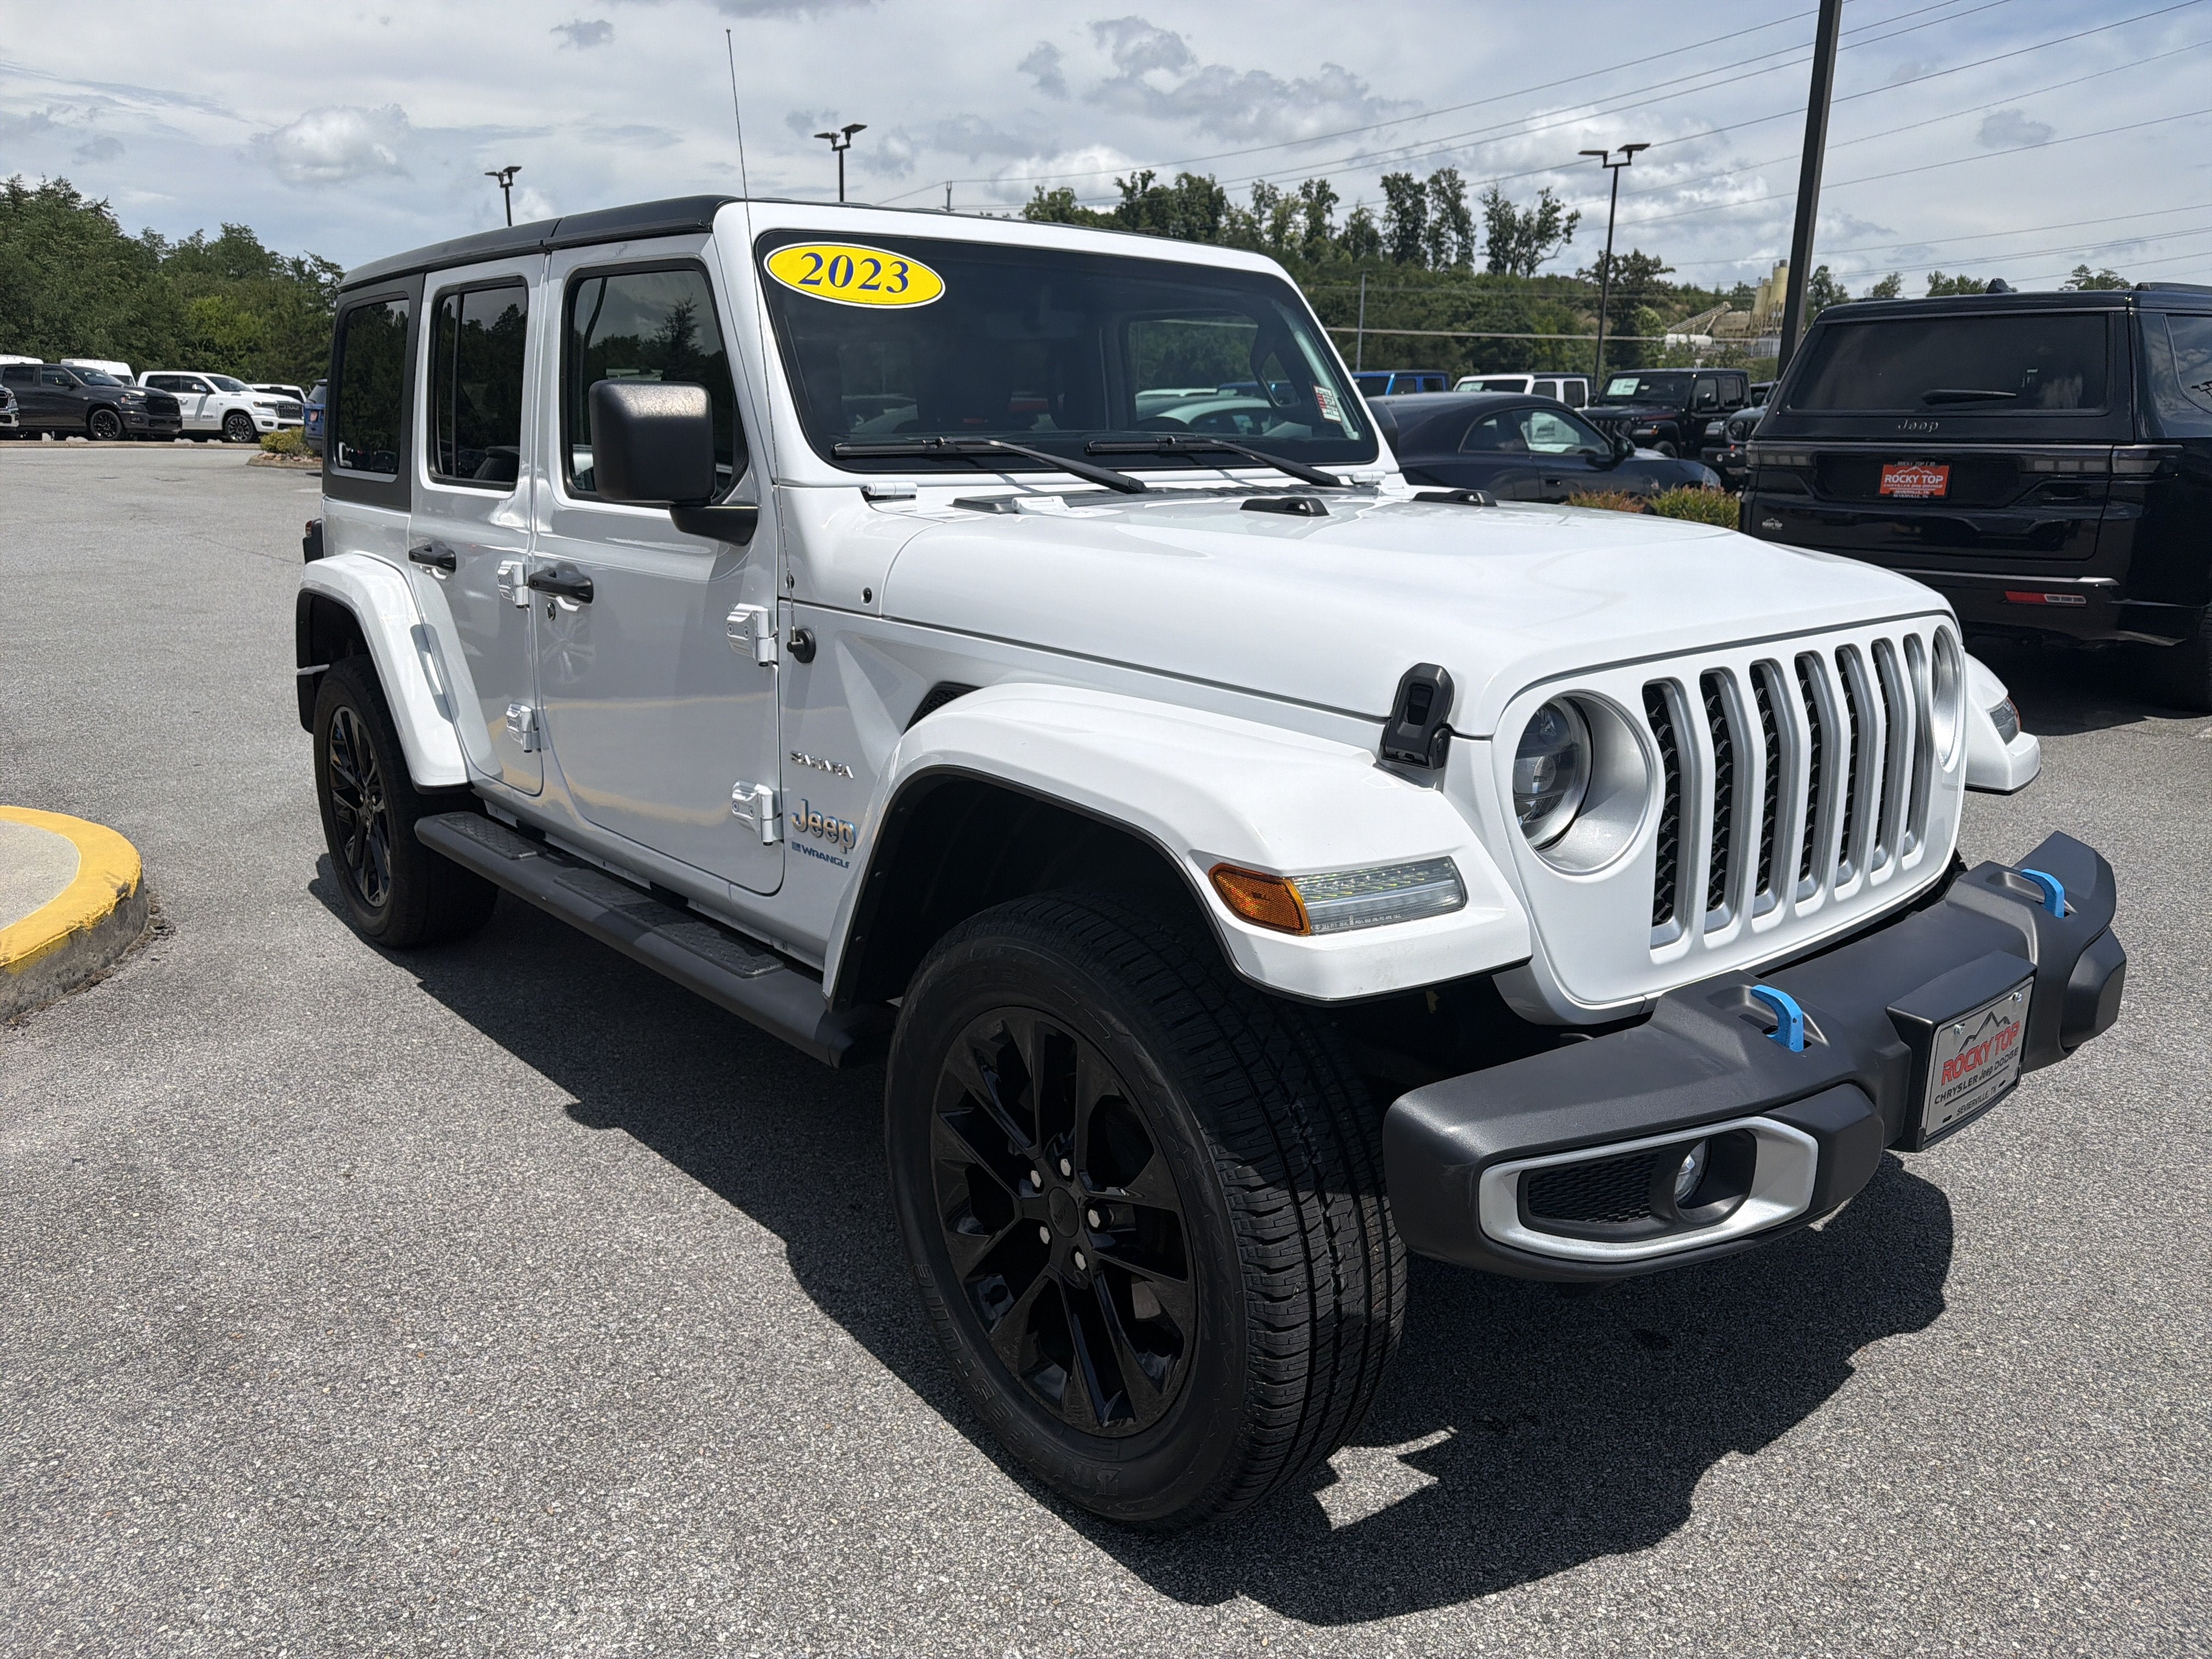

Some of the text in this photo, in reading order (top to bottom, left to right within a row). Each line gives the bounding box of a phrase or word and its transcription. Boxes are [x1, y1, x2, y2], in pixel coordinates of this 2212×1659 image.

[797, 252, 909, 294] 2023
[1884, 475, 1944, 484] ROCKY TOP
[790, 750, 854, 778] SAHARA
[791, 798, 856, 854] Jeep
[1934, 1046, 2019, 1105] CHRYSLER Jeep DODGE
[1941, 1020, 2020, 1086] ROCKY TOP
